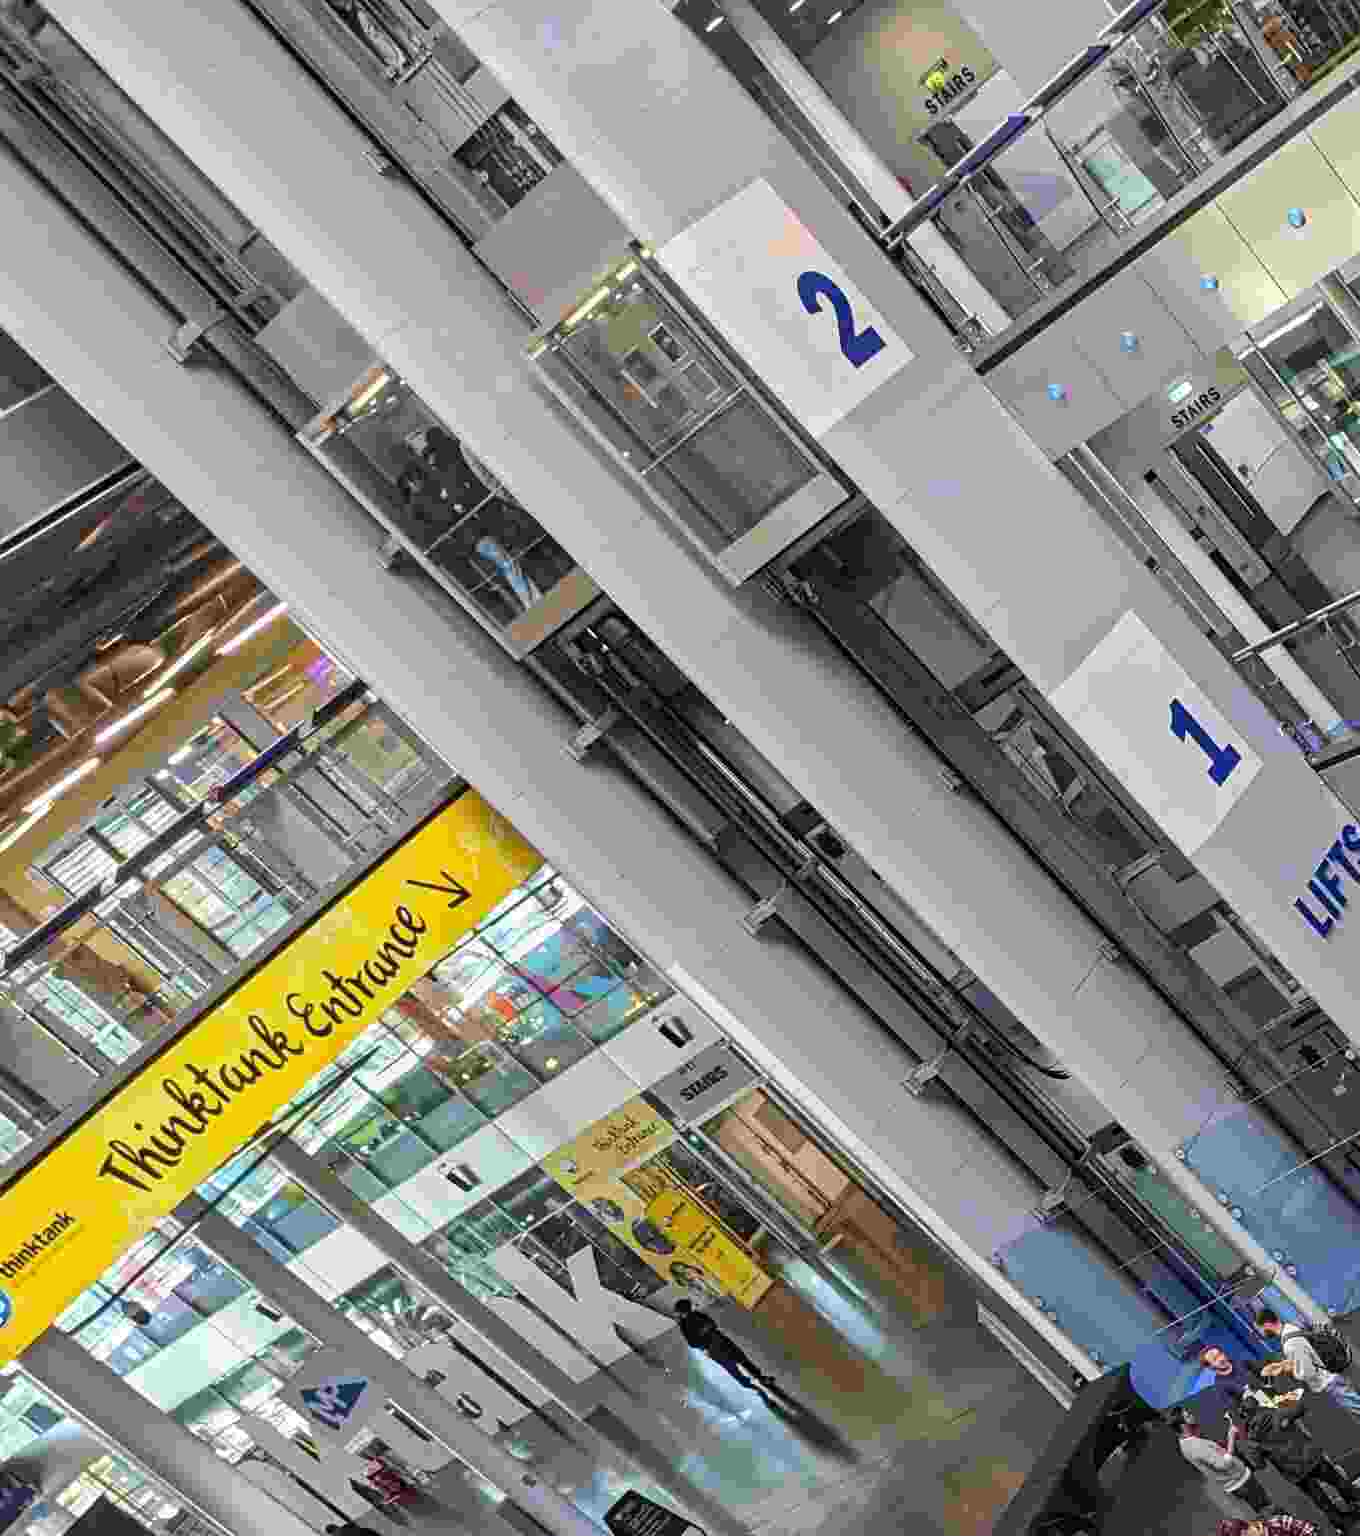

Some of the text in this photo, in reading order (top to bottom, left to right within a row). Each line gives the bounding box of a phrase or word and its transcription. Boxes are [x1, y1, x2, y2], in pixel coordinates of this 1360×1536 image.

[925, 66, 976, 114] STAIRS
[797, 271, 887, 369] 2
[1170, 387, 1221, 429] STAIRS
[1169, 698, 1242, 787] 1
[98, 905, 427, 1192] Thinktank Entrance
